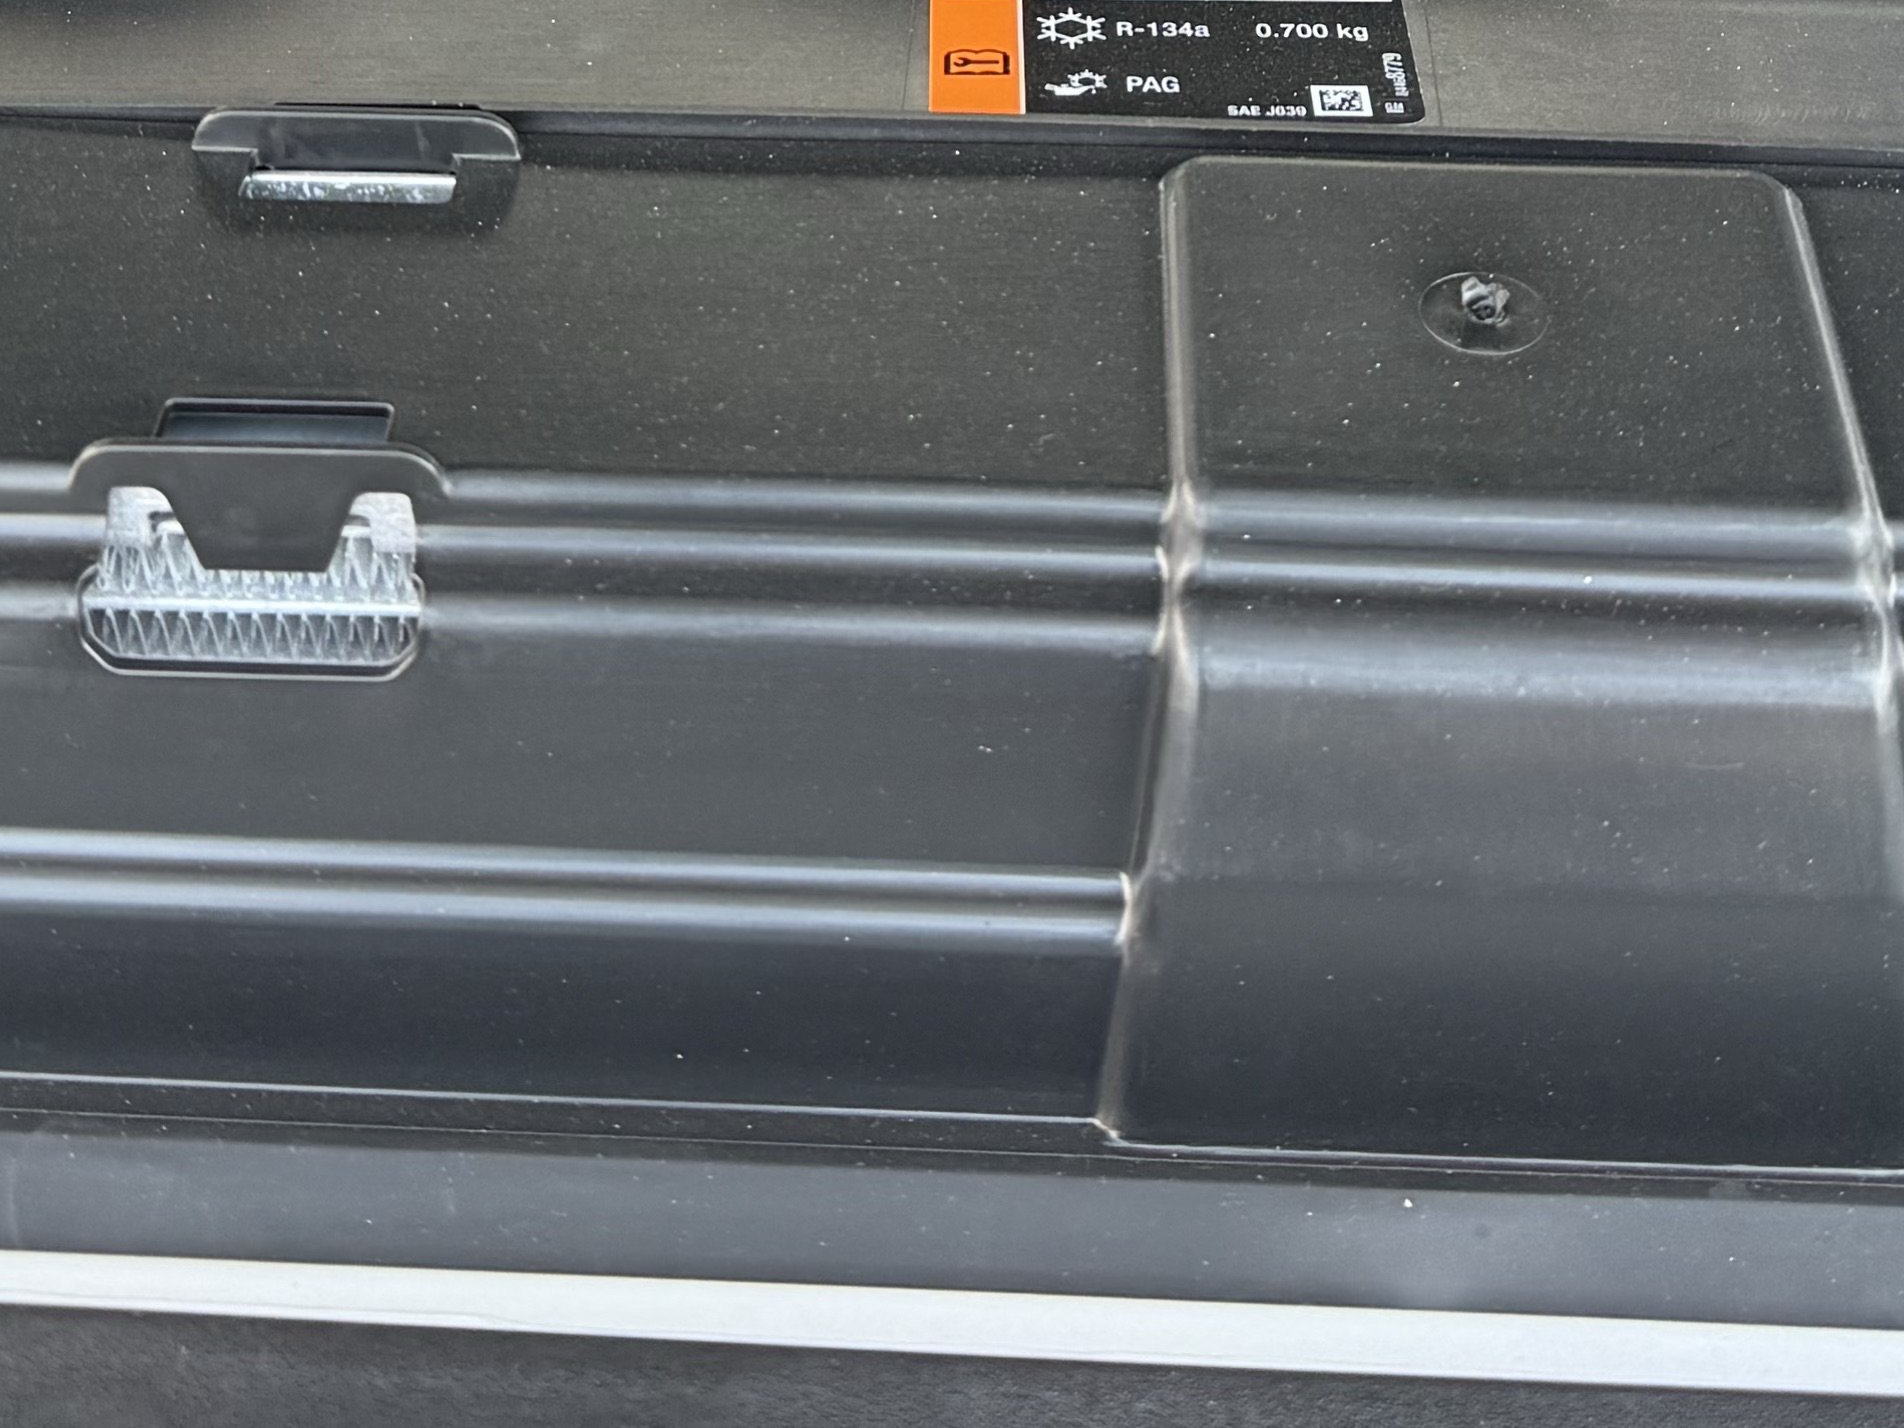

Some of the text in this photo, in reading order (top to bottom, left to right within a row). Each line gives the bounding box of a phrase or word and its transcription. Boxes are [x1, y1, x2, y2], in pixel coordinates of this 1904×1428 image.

[1116, 21, 1369, 42] R-134a 0.700 kg
[1126, 75, 1181, 94] PAG
[1227, 105, 1261, 117] SAE
